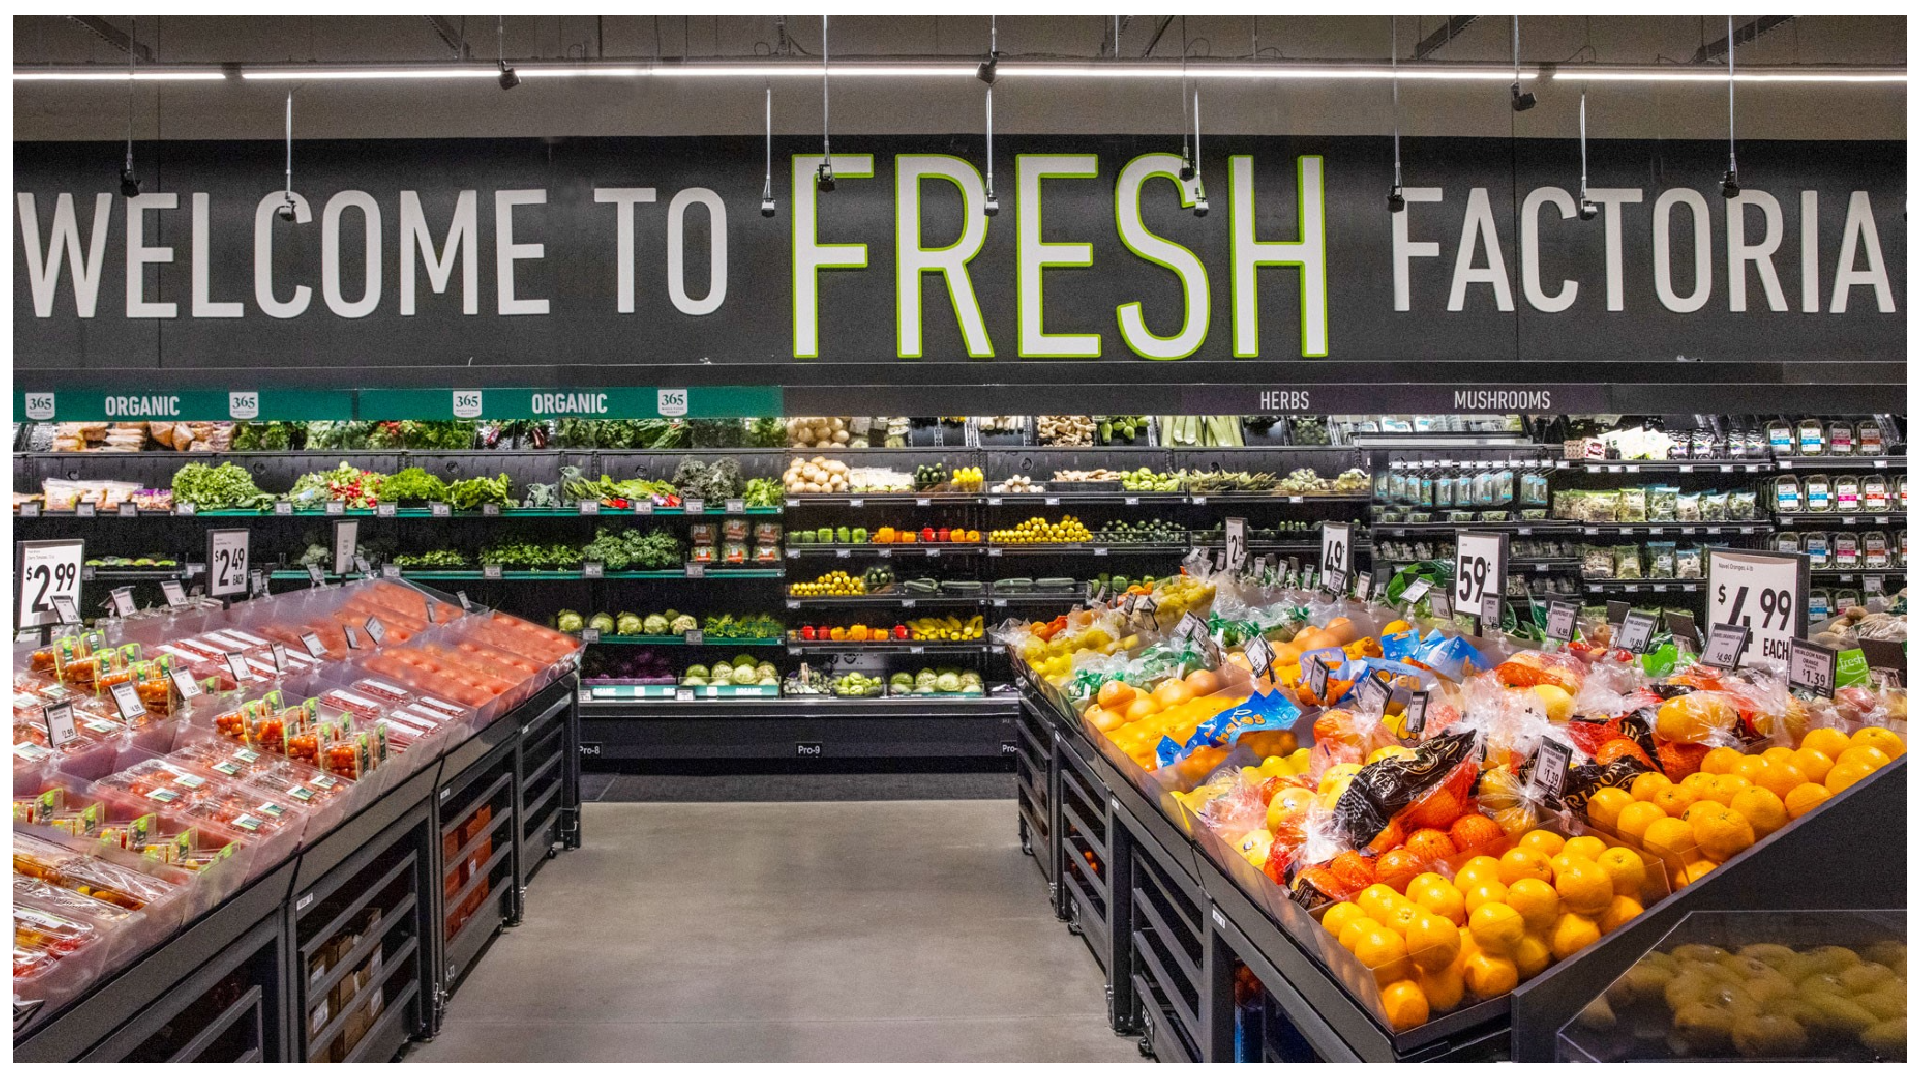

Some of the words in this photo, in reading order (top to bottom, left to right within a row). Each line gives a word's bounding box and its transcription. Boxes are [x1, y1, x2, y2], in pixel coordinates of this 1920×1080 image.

[17, 188, 551, 319] WELCOME
[593, 187, 728, 316] TO
[790, 152, 1330, 360] FRESH
[1393, 186, 1896, 314] FACTORIA
[29, 397, 52, 410] 365
[105, 395, 181, 416] ORGANIC
[232, 397, 255, 409] 365
[456, 395, 478, 407] 365
[531, 393, 608, 415] ORGANIC
[662, 393, 684, 405] 365
[1259, 390, 1310, 411] HERBS
[1453, 390, 1551, 410] MUSHROOMS
[1763, 637, 1789, 661] EACH
[1794, 648, 1816, 658] HEIRLOOM
[1716, 652, 1732, 664] $4.99
[1803, 657, 1819, 667] ORANGE
[1839, 654, 1866, 669] fresh
[1802, 668, 1826, 687] $1.39
[797, 745, 821, 755] Pro-9
[1002, 744, 1017, 753] Pro-
[1543, 768, 1560, 786] $1.39
